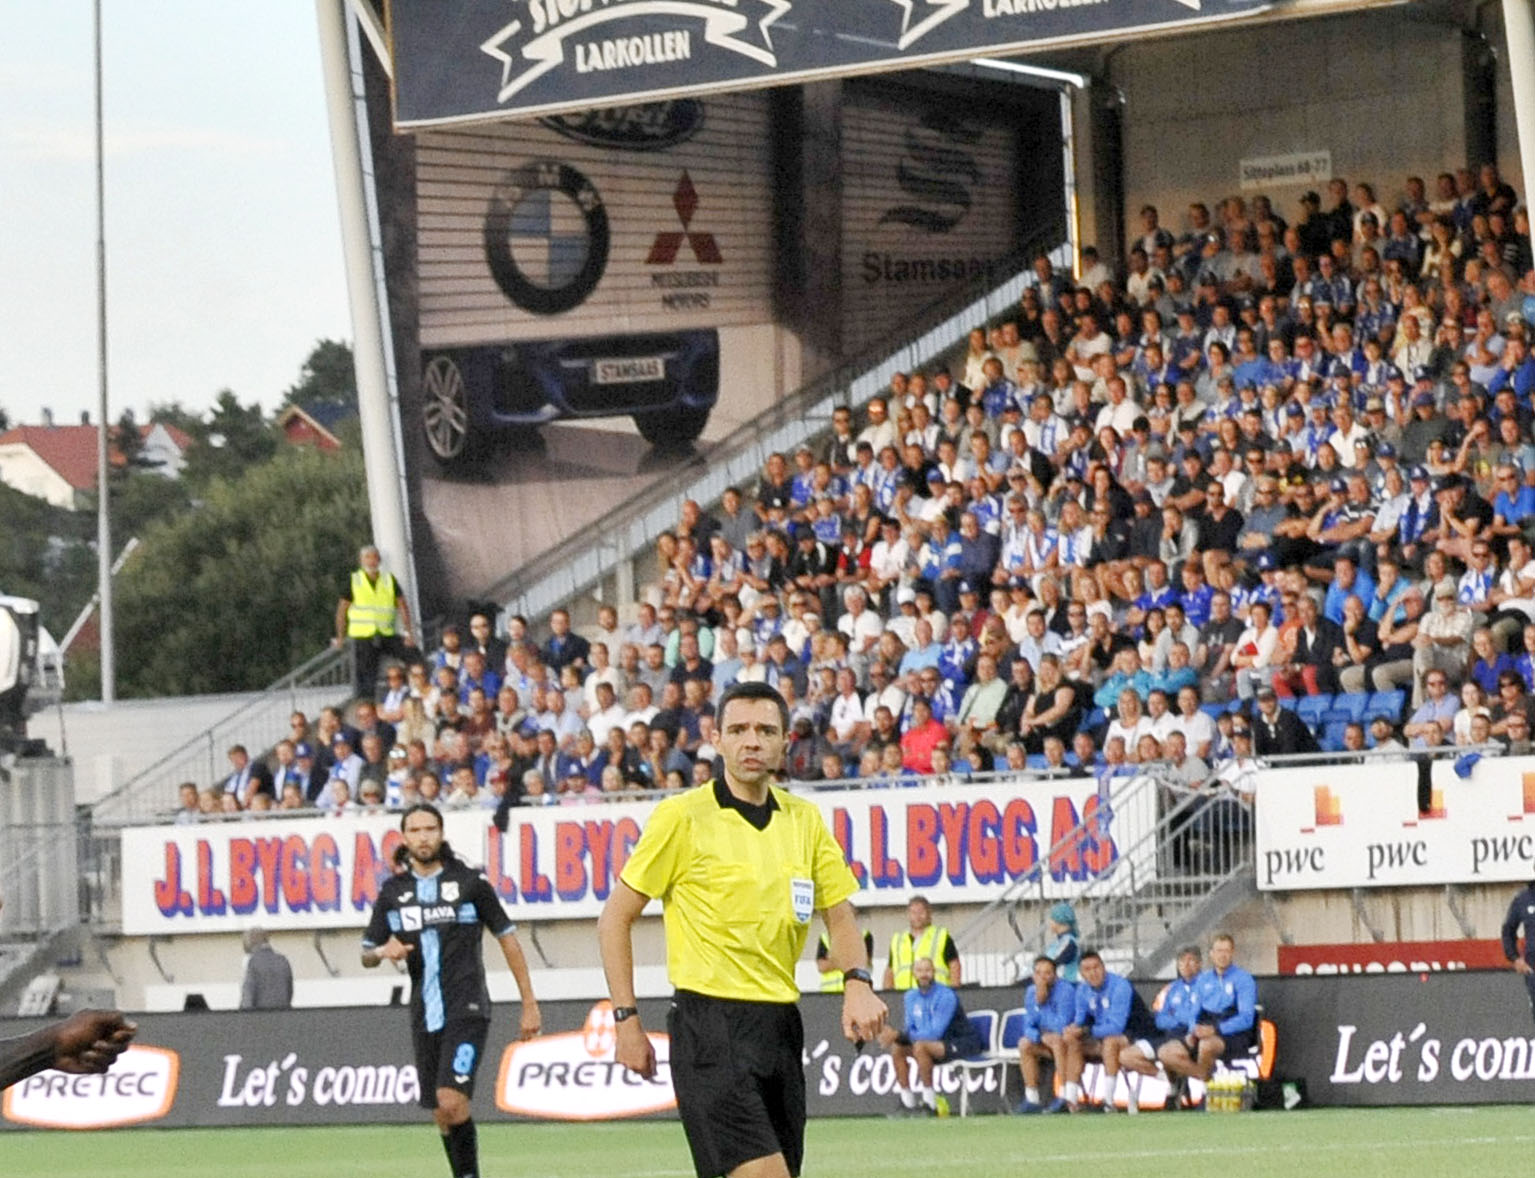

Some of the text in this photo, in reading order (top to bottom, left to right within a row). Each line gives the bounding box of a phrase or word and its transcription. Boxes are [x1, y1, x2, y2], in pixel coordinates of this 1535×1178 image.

[575, 30, 691, 73] LARKOLLEN
[1265, 846, 1325, 885] pwc
[1367, 840, 1428, 880] pwc
[1471, 834, 1535, 873] pwc
[423, 905, 456, 922] SAVA
[452, 1042, 475, 1075] 8
[1329, 1022, 1441, 1083] Let's
[217, 1052, 310, 1107] Let's
